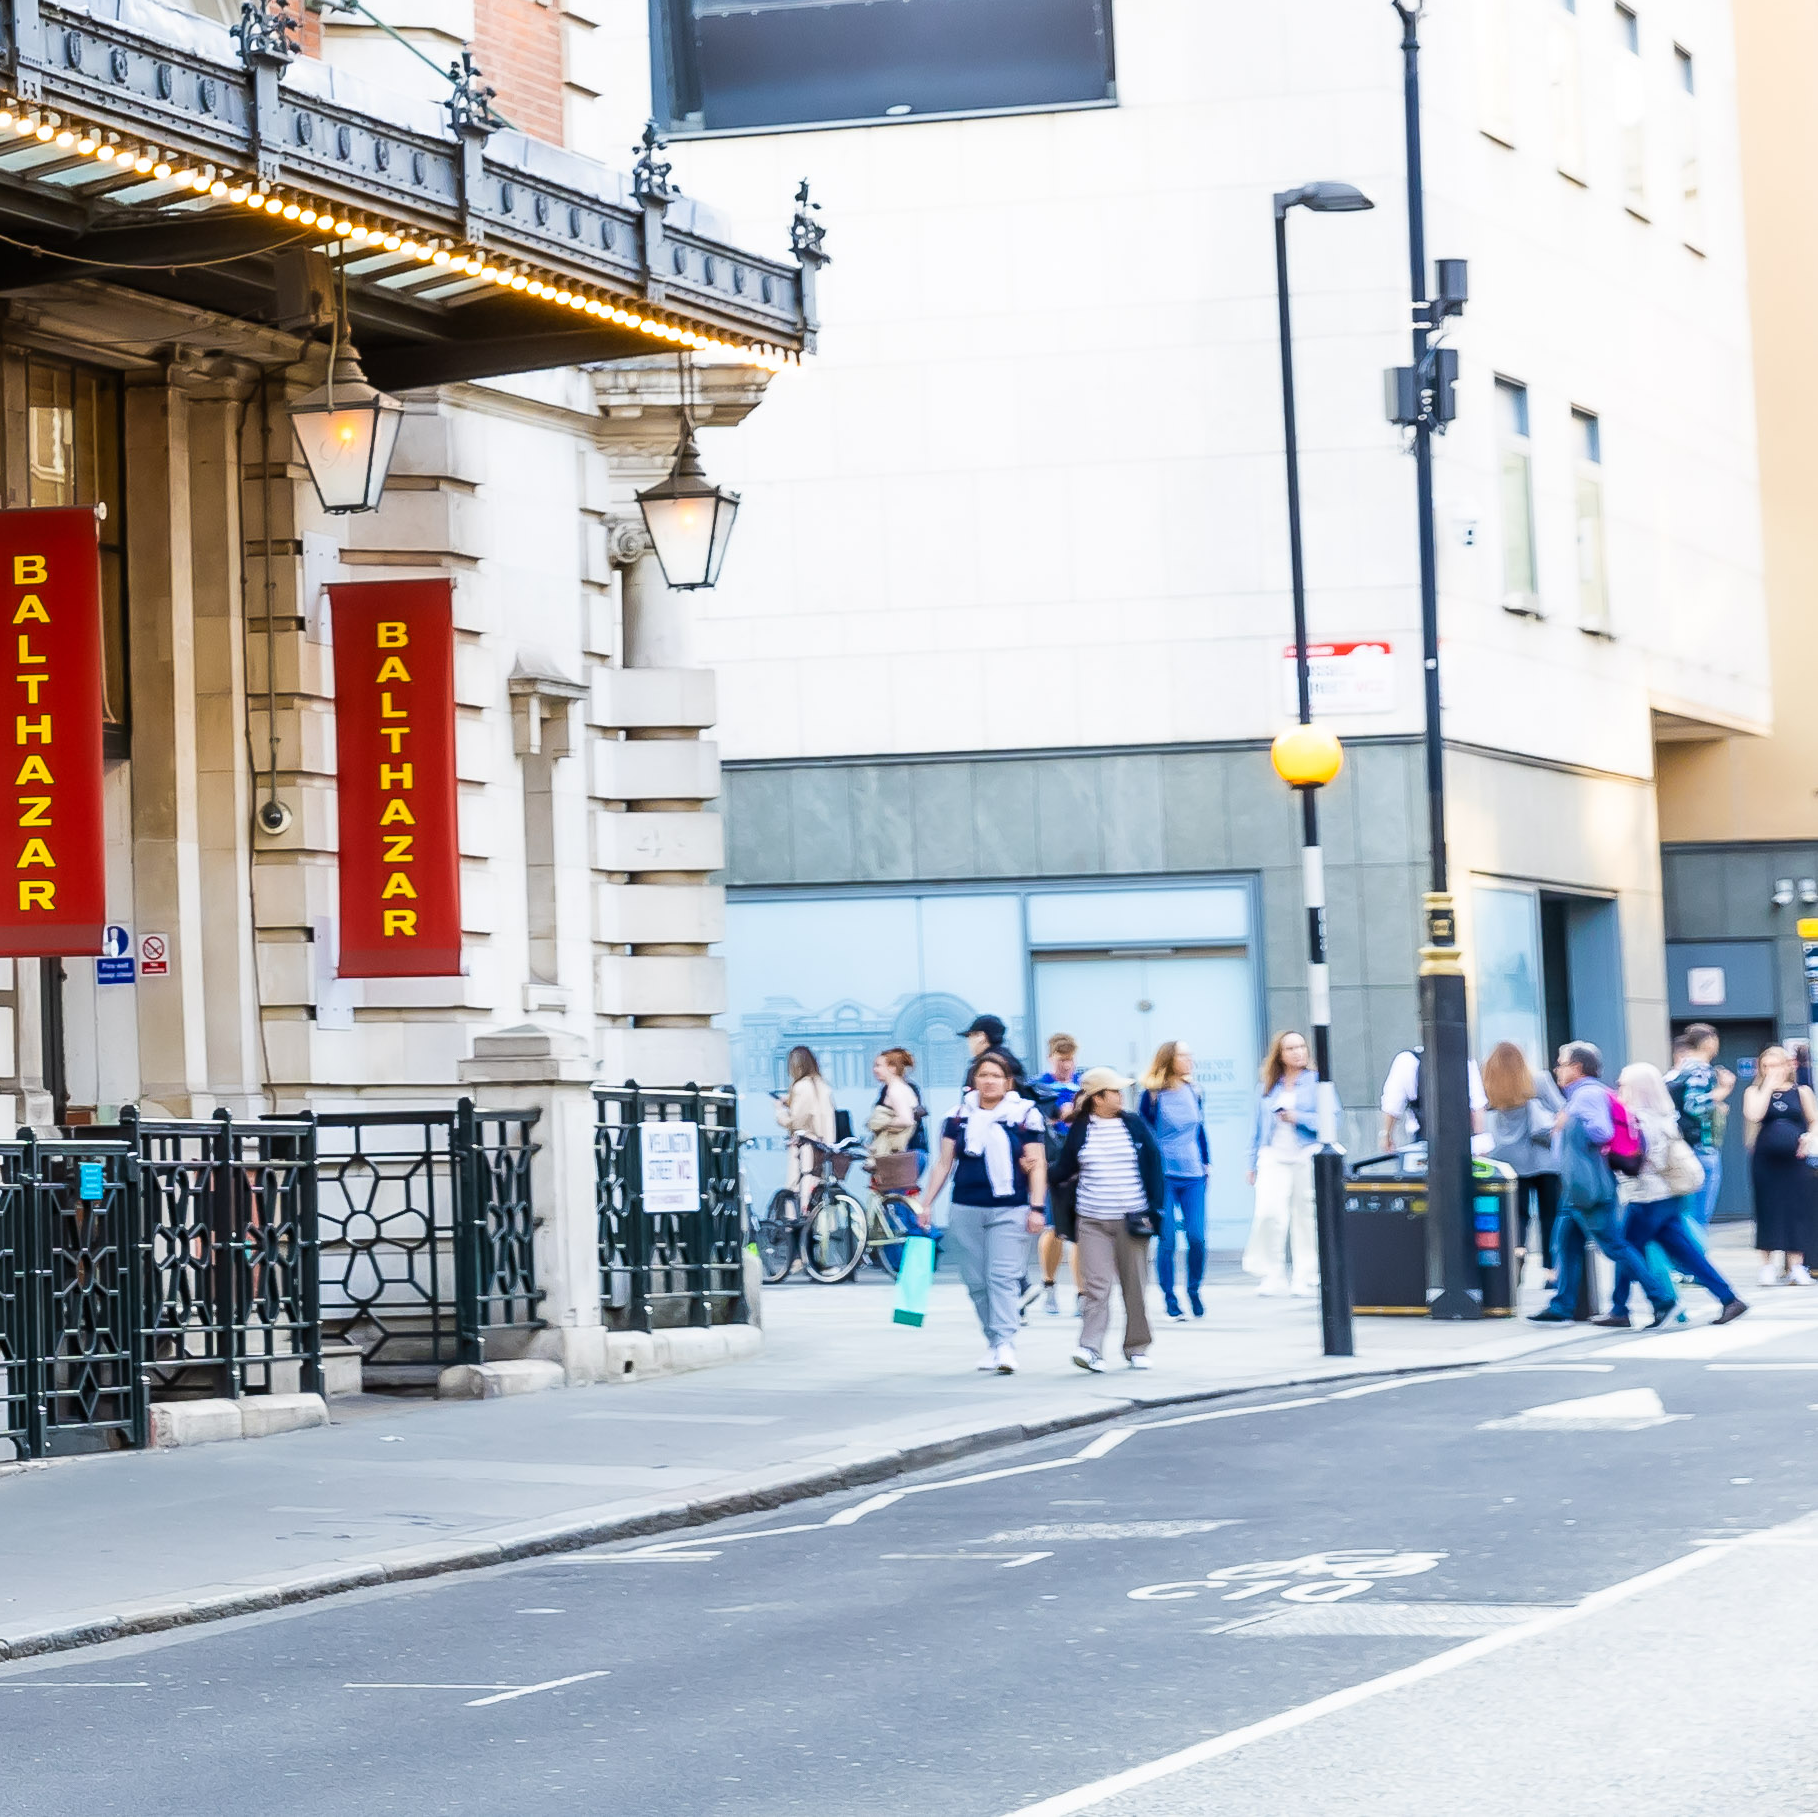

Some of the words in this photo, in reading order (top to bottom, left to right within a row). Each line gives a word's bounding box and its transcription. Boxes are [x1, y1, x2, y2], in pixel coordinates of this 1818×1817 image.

[11, 554, 57, 912] BALTHAZAR
[375, 620, 419, 938] BALTHAZAR
[1127, 1580, 1375, 1603] C10
